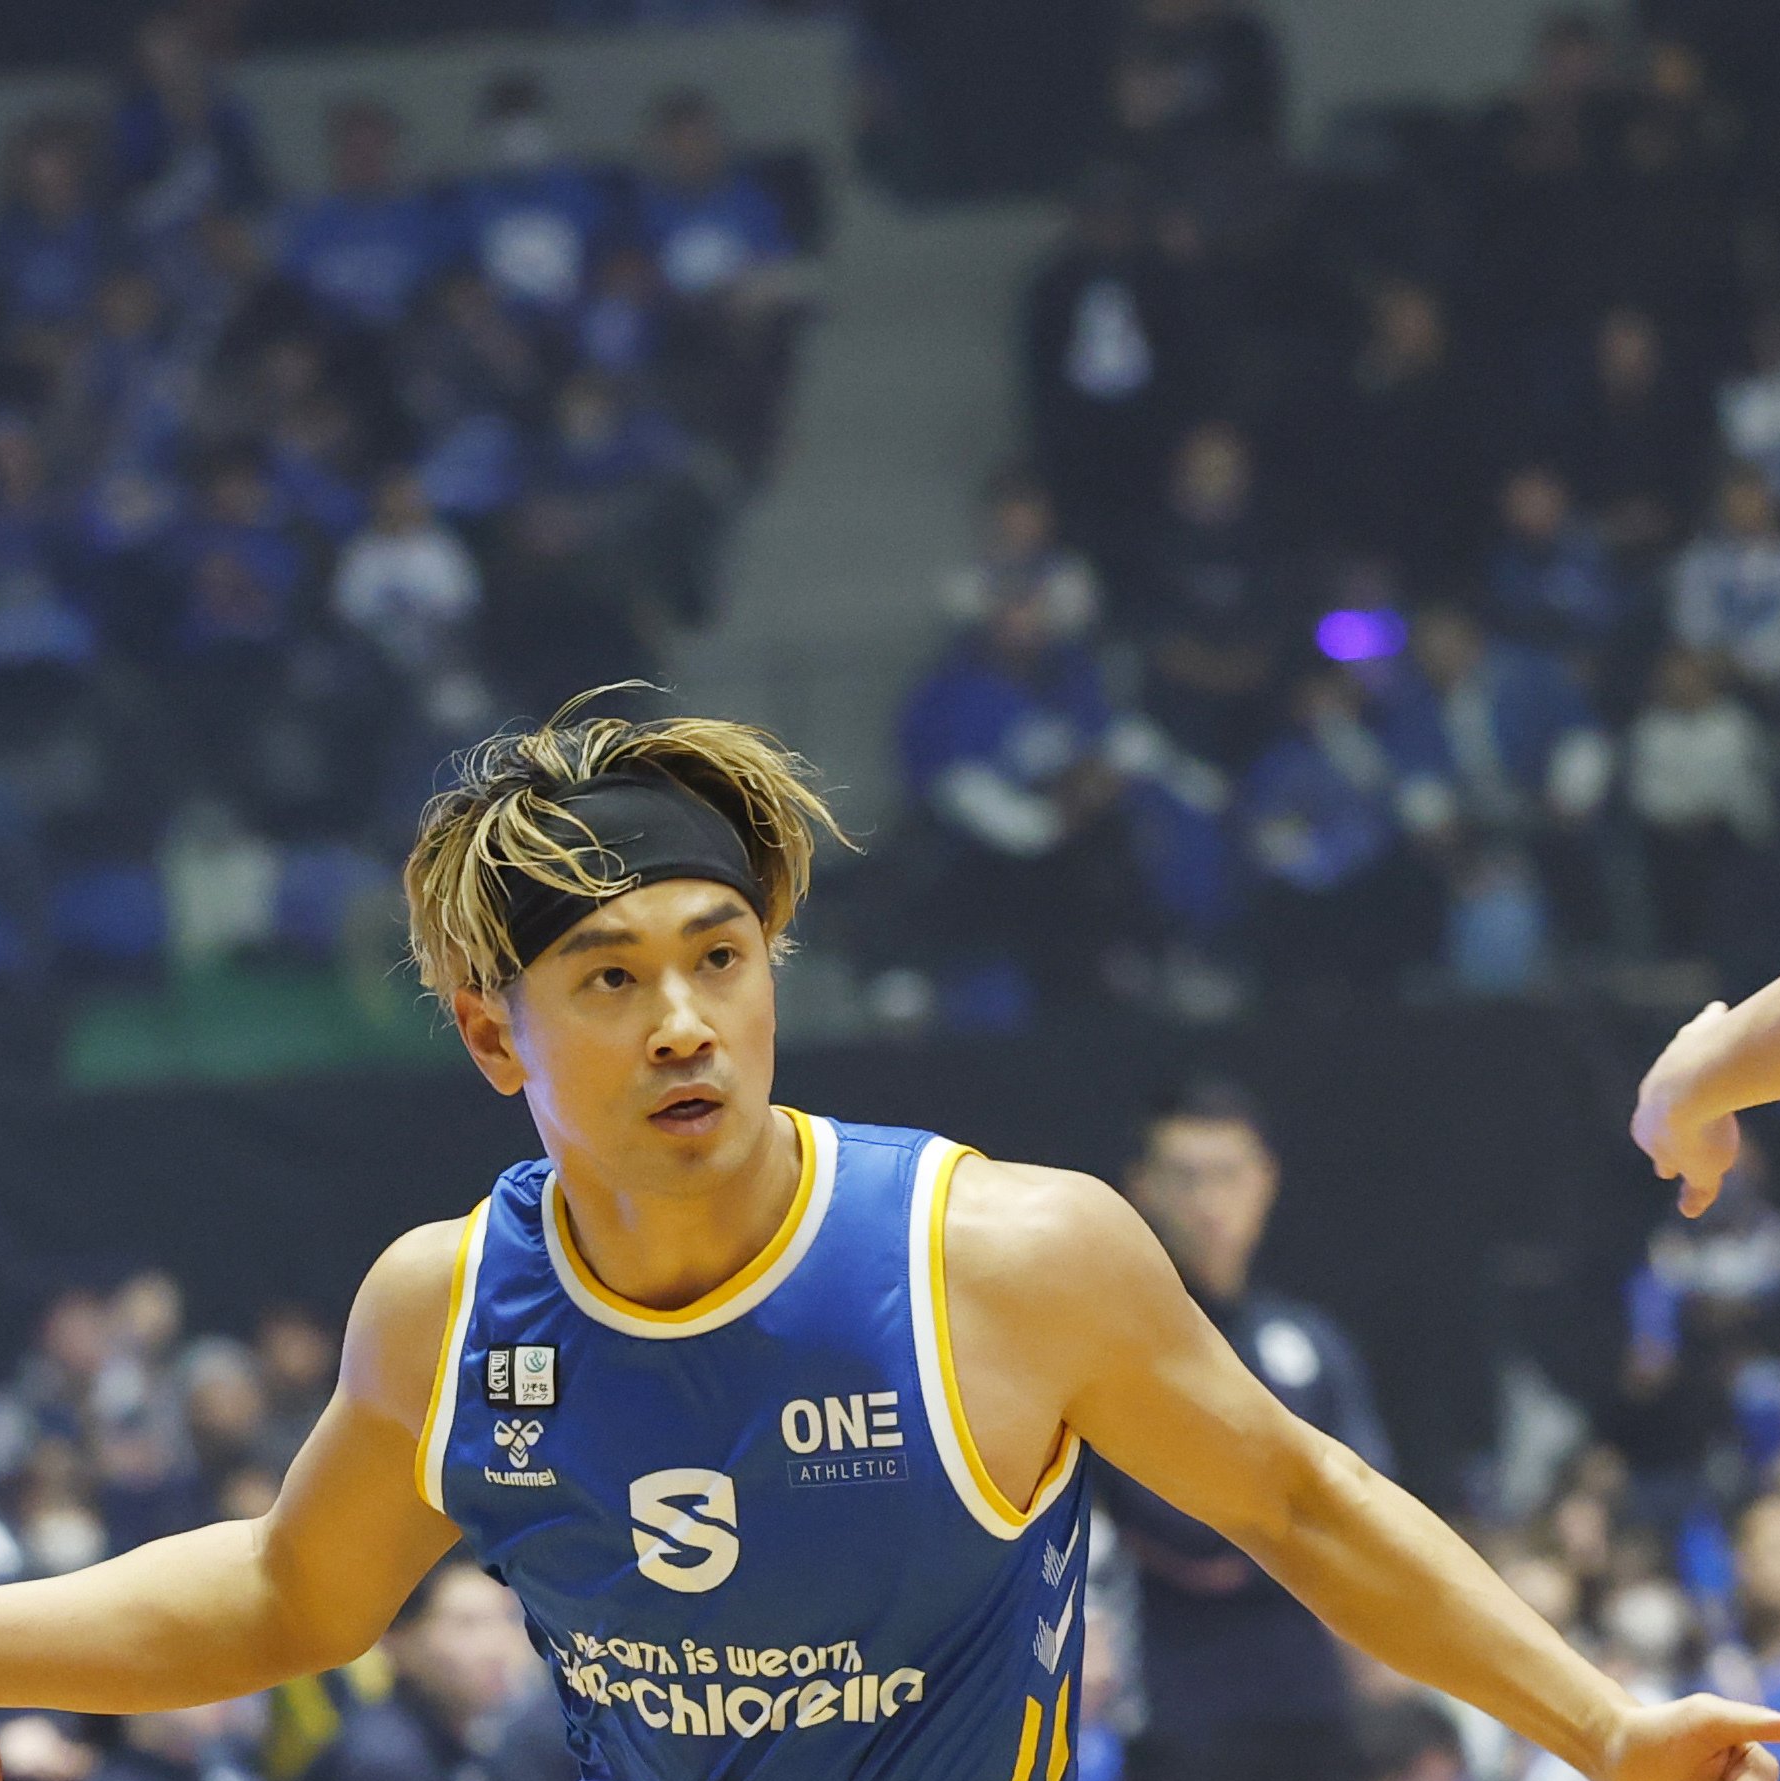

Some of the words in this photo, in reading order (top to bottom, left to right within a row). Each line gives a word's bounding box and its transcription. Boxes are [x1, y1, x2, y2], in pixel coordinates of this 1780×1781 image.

[521, 1382, 549, 1393] りそな
[781, 1391, 904, 1454] ONE
[484, 1465, 557, 1487] hummel
[800, 1459, 898, 1481] ATHLETIC
[680, 1638, 719, 1676] is
